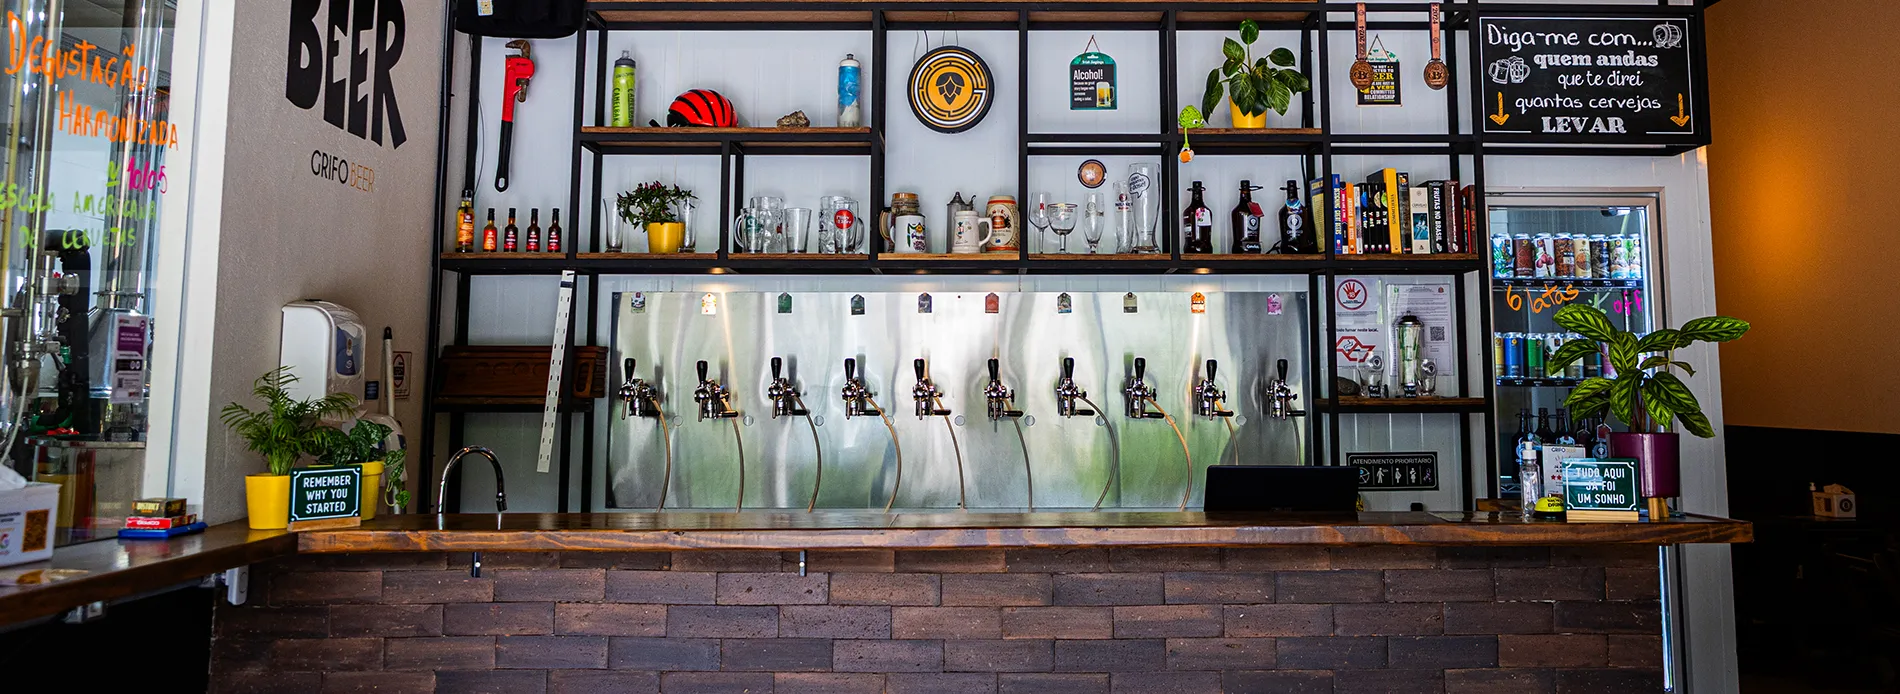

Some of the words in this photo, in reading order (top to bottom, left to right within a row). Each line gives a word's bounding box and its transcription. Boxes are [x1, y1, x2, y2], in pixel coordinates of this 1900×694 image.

[1487, 23, 1580, 52] Diga-me
[1588, 32, 1653, 46] com...
[1533, 54, 1593, 69] quem
[1596, 50, 1658, 67] andas
[286, 0, 407, 150] BEER
[1073, 69, 1103, 80] Alcohol!
[1373, 72, 1394, 80] EER
[1558, 73, 1585, 89] que
[1586, 71, 1604, 86] te
[1607, 70, 1643, 86] direi
[1515, 93, 1583, 114] quantas
[1588, 96, 1662, 112] cervejas
[58, 90, 178, 151] HARMONIZADA
[1541, 116, 1627, 133] LEVAR
[127, 156, 168, 194] 10/05
[311, 150, 349, 184] GRIFO
[350, 162, 375, 193] BEER
[73, 190, 157, 222] AMERICANA
[1433, 187, 1441, 210] FRUTAS
[1434, 211, 1441, 220] NO
[1434, 220, 1442, 242] BRASIL
[1506, 284, 1522, 311] 6
[1525, 284, 1579, 314] latas
[1613, 289, 1643, 317] off
[303, 475, 351, 488] REMEMBER
[1576, 468, 1600, 478] TUDO
[1604, 468, 1625, 479] AQUI
[306, 489, 327, 500] WHY
[330, 488, 348, 499] YOU
[1601, 481, 1616, 490] FOI
[305, 501, 346, 514] STARTED
[1577, 494, 1592, 504] UM
[1594, 494, 1625, 504] SONHO
